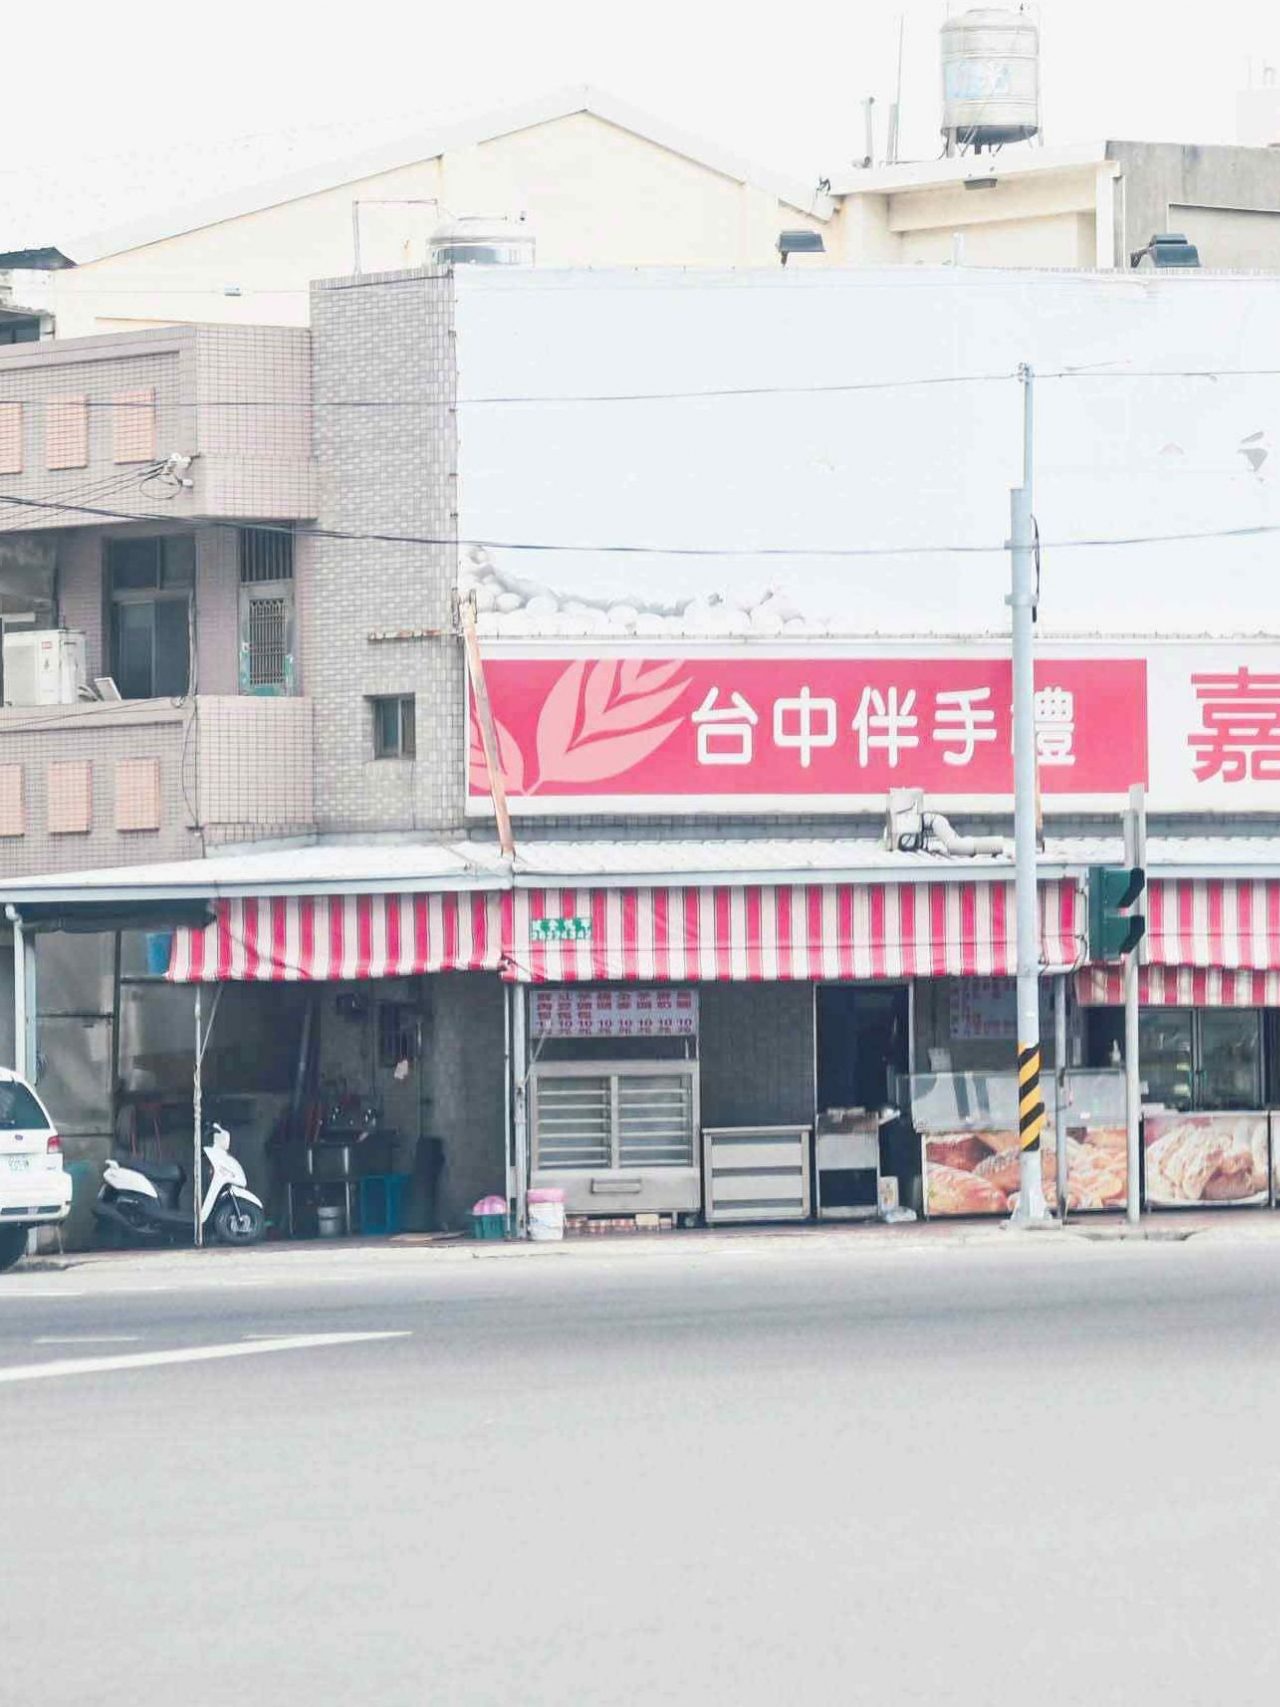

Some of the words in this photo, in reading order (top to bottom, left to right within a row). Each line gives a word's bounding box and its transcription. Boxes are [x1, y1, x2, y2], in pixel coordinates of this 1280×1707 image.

[691, 686, 1076, 768] 台中伴手禮
